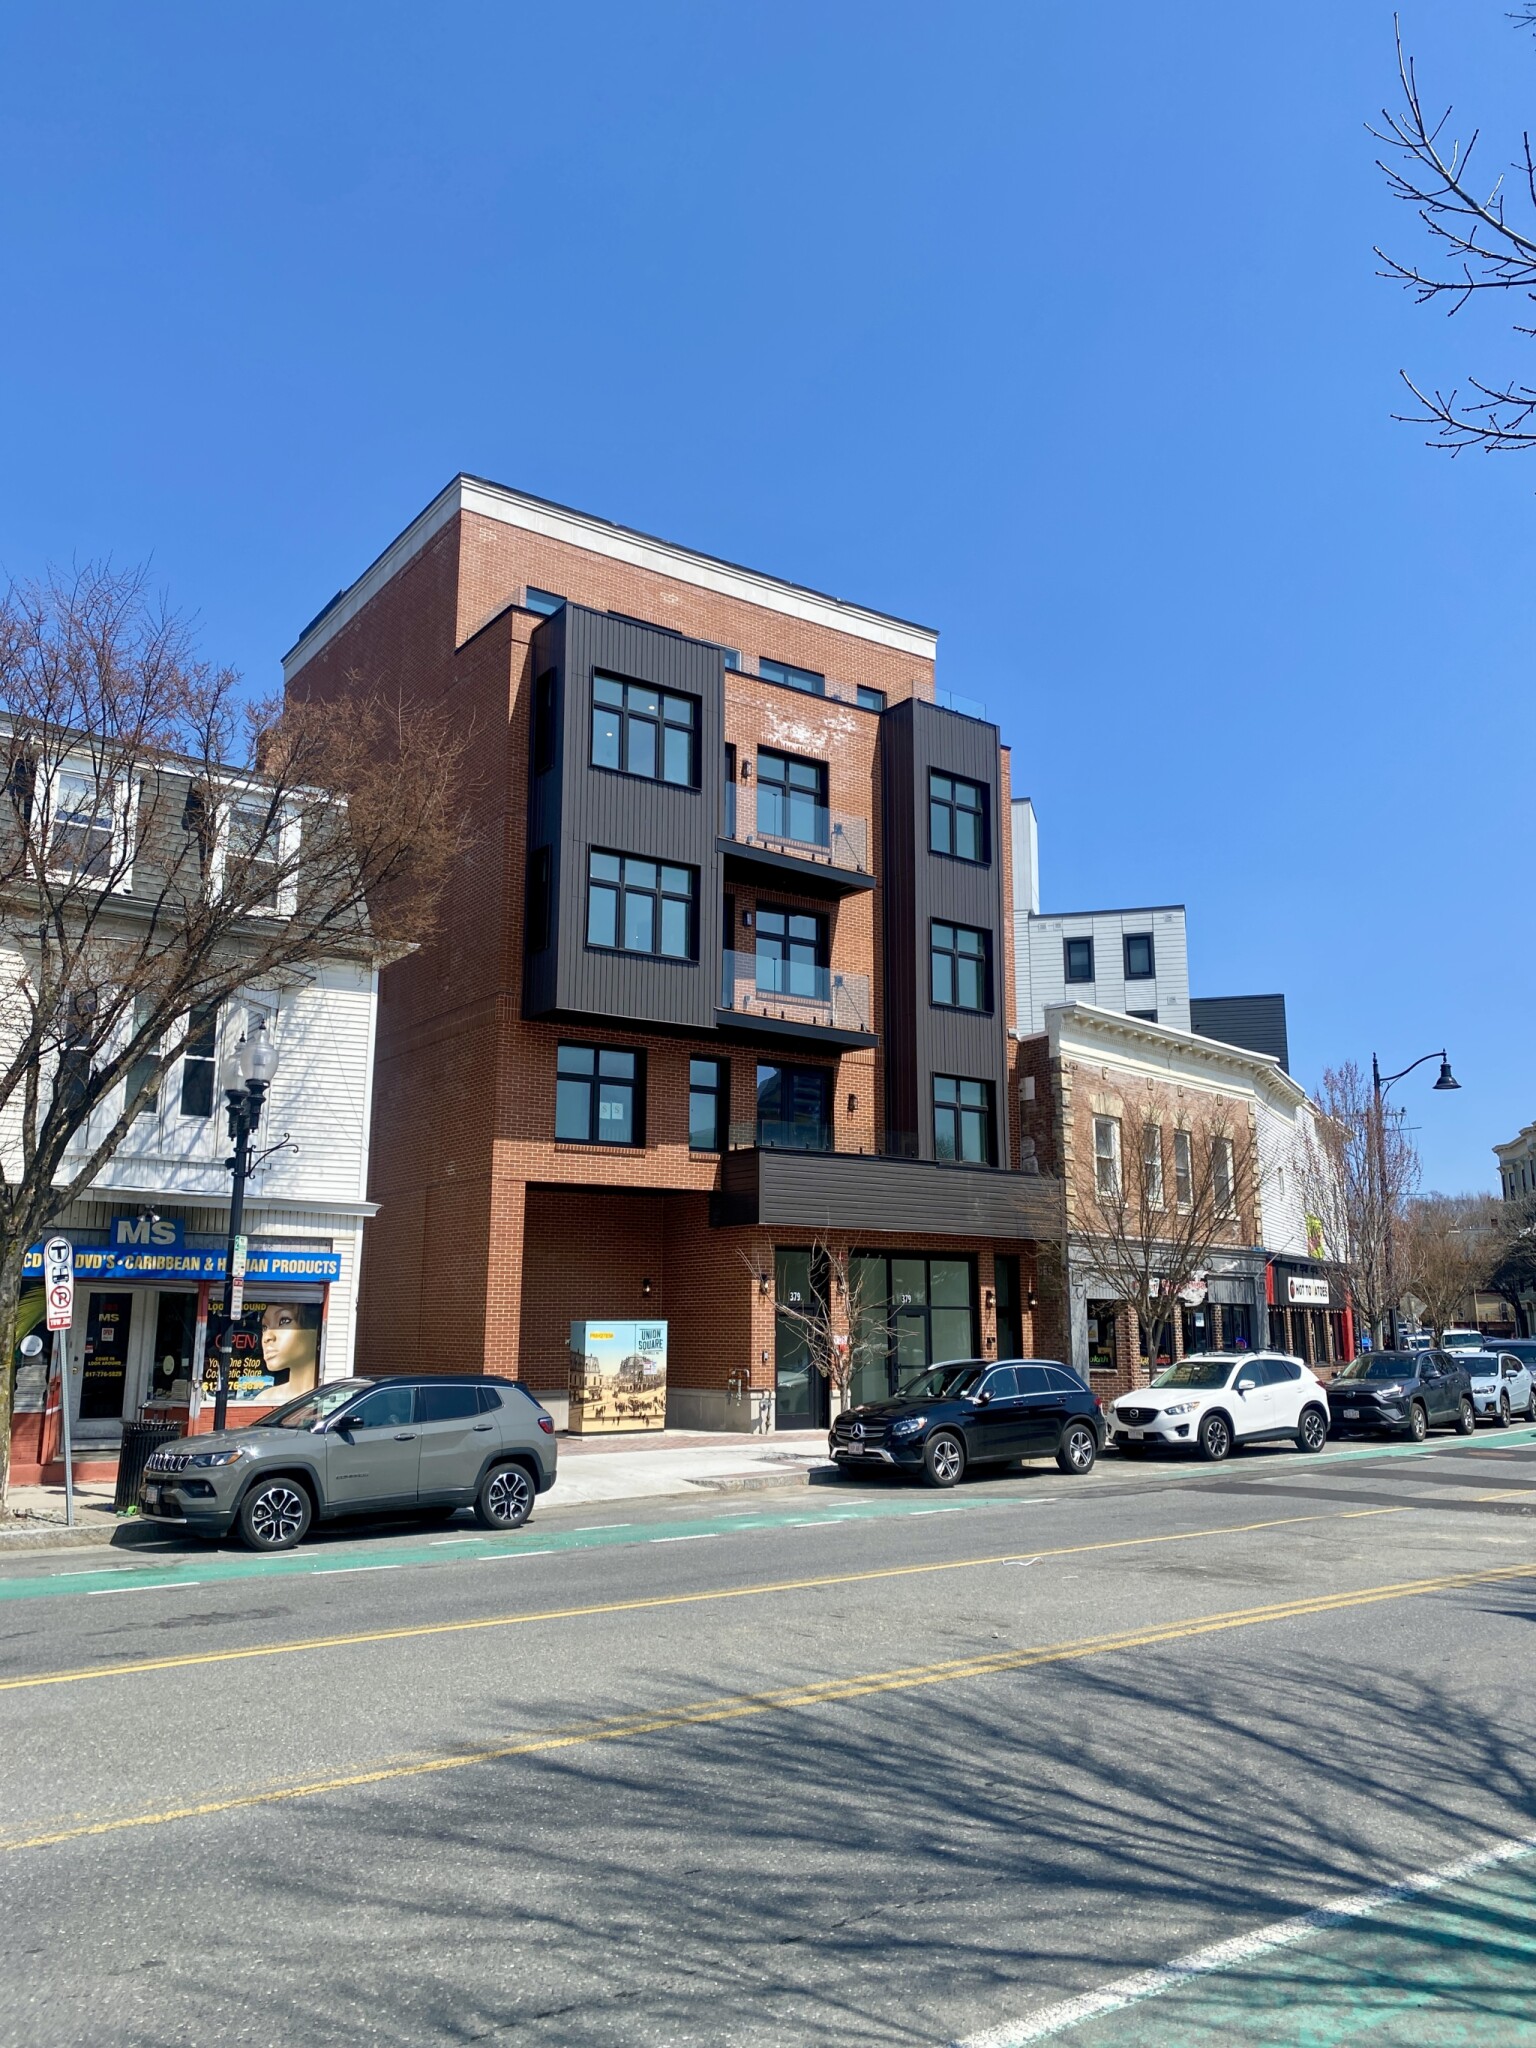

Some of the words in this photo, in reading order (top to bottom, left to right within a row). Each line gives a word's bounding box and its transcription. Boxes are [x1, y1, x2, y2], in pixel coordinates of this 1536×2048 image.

[116, 1220, 176, 1245] MS
[74, 1255, 115, 1269] DVD'S
[124, 1255, 200, 1271] CARIBBEAN
[203, 1258, 214, 1271] &
[217, 1258, 268, 1273] HIAN
[271, 1259, 337, 1275] PRODUCTS
[789, 1291, 801, 1301] 379
[901, 1294, 911, 1303] 379
[208, 1303, 224, 1311] LOO
[98, 1313, 120, 1322] MS
[641, 1329, 661, 1341] UNION
[638, 1338, 663, 1351] SQUARE
[243, 1357, 261, 1368] Stop
[242, 1368, 262, 1377] Store
